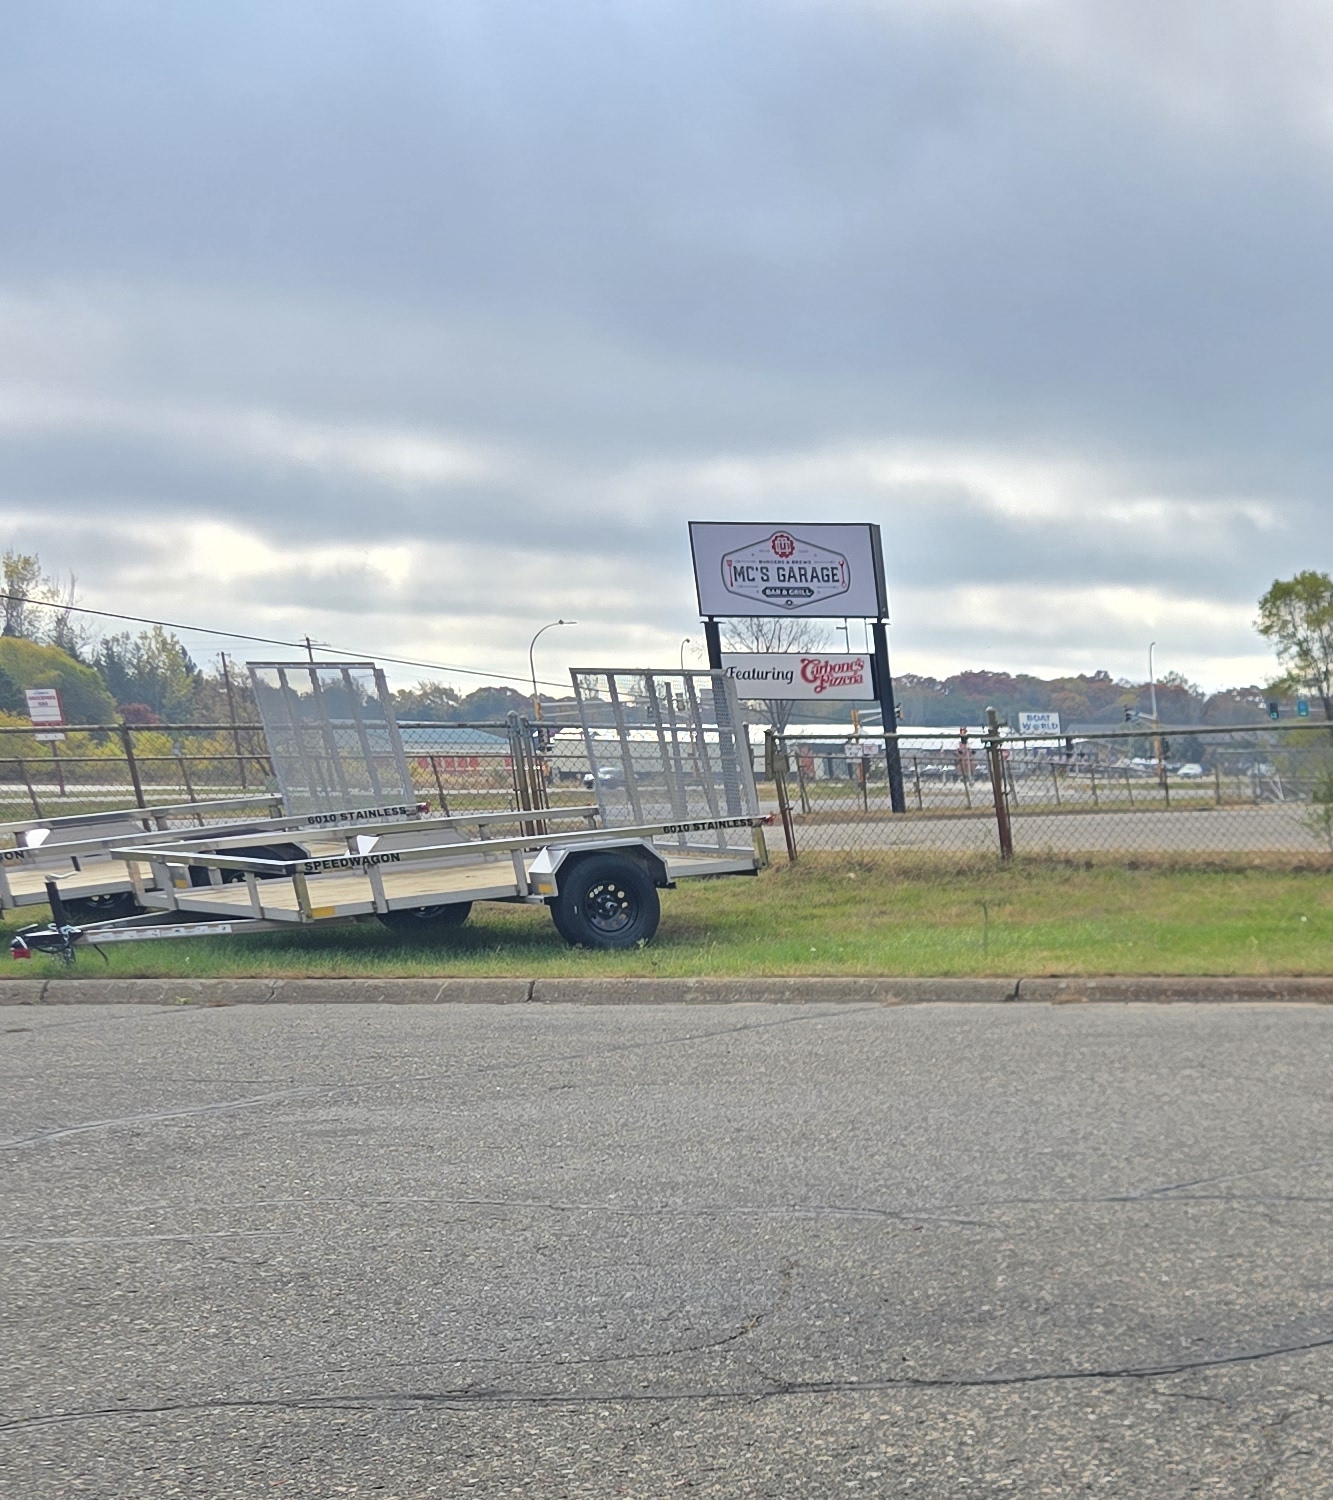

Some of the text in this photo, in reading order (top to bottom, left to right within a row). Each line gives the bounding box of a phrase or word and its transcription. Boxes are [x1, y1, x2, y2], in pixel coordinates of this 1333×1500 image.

[732, 565, 840, 583] MC'S GARAGE
[765, 588, 781, 596] BAR
[788, 588, 812, 596] GRILL
[725, 665, 794, 685] Featuring
[307, 806, 407, 825] 6010 STAINLESS
[663, 818, 754, 834] 6010 STAINLESS
[304, 852, 401, 871] SPEEDWAGON
